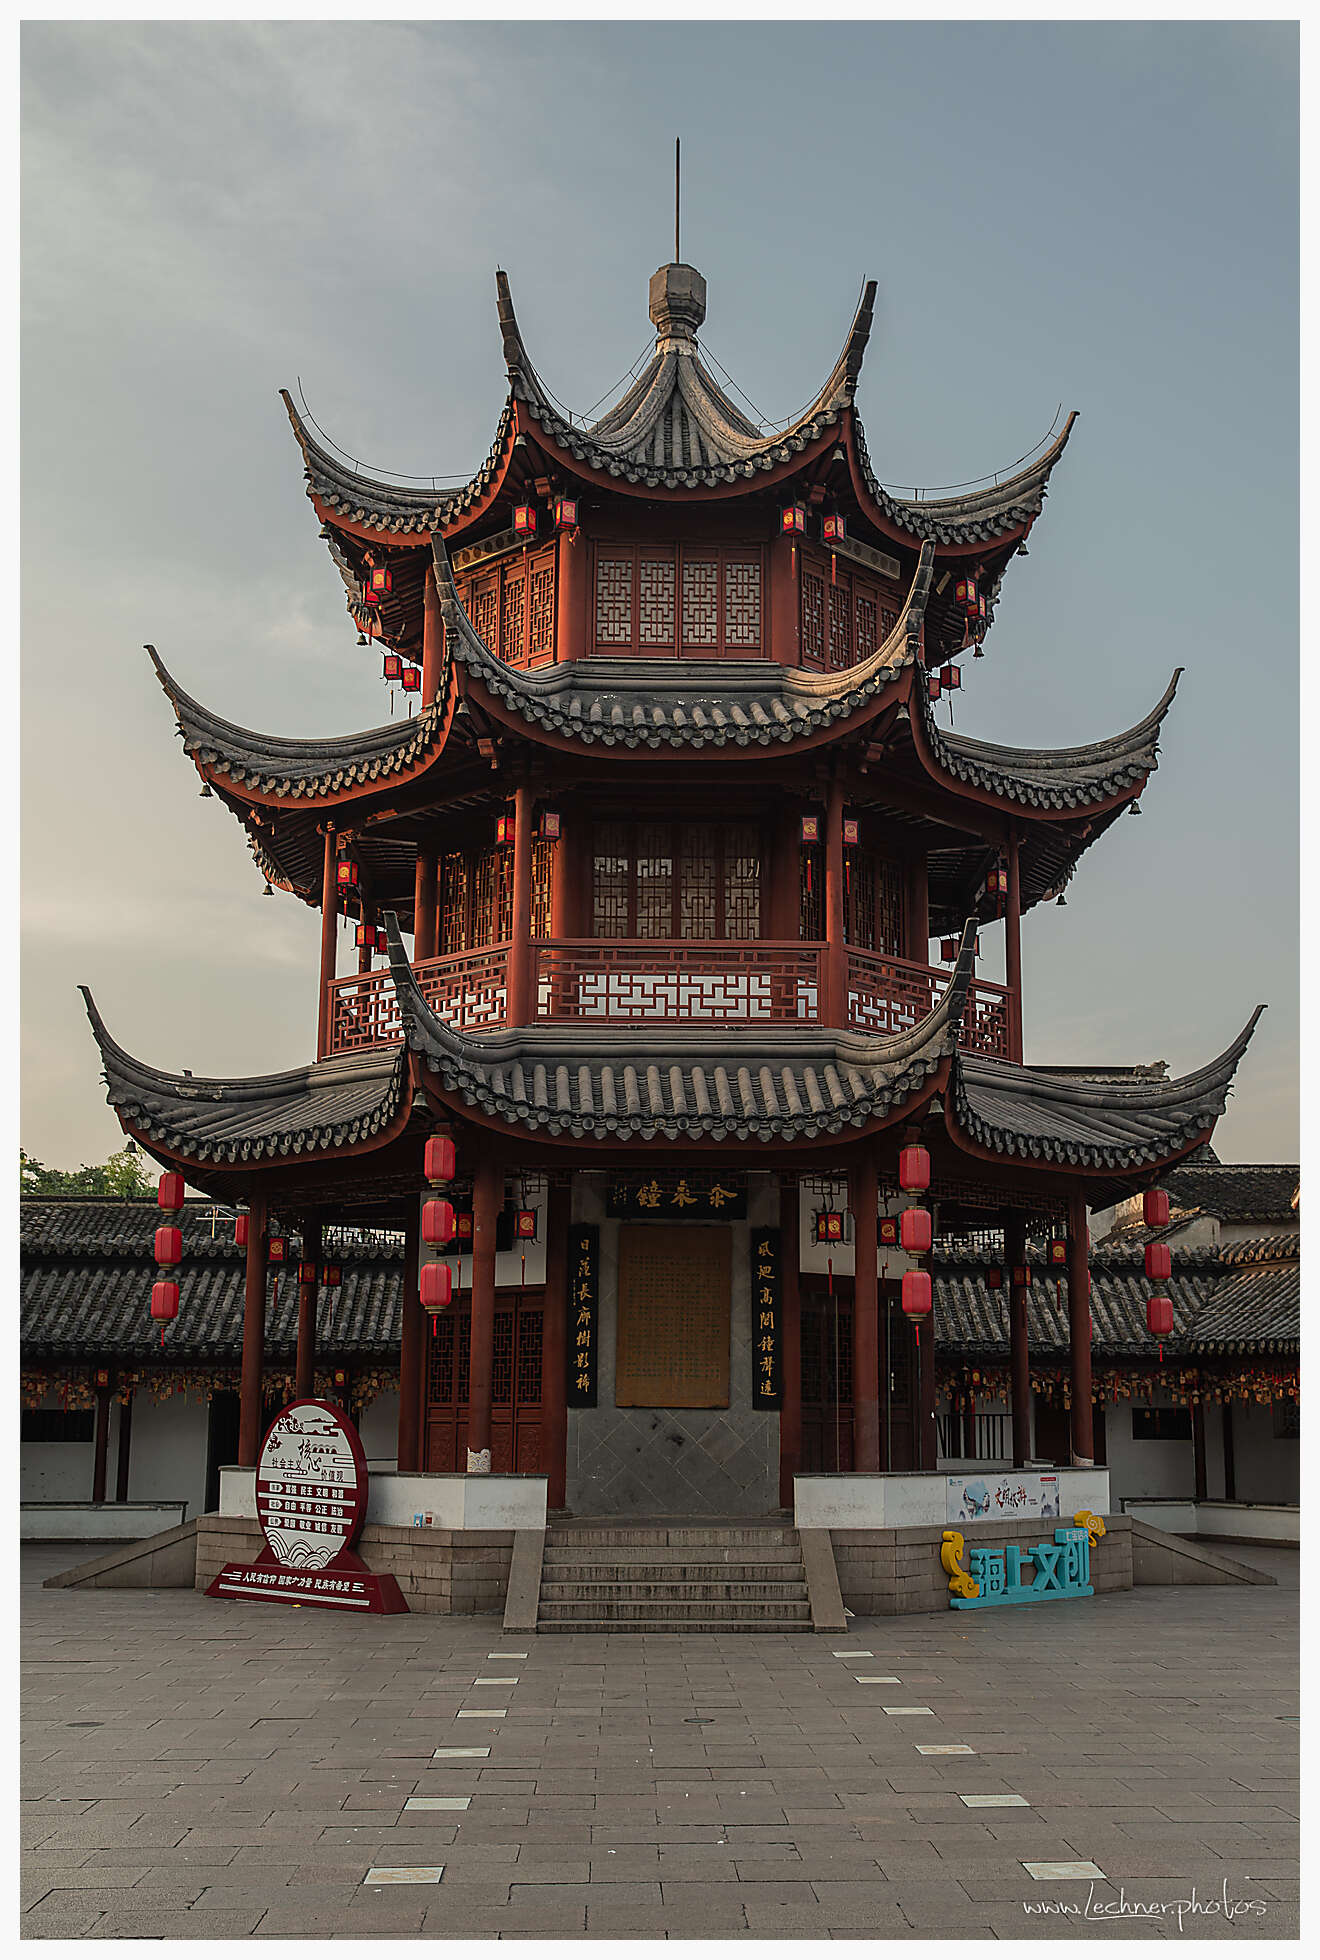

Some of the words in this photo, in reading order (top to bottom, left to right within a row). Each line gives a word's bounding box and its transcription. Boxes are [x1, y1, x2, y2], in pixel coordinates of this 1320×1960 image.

[300, 1486, 313, 1496] 民主
[315, 1505, 328, 1515] 公正
[971, 1541, 1089, 1598] 海上文创
